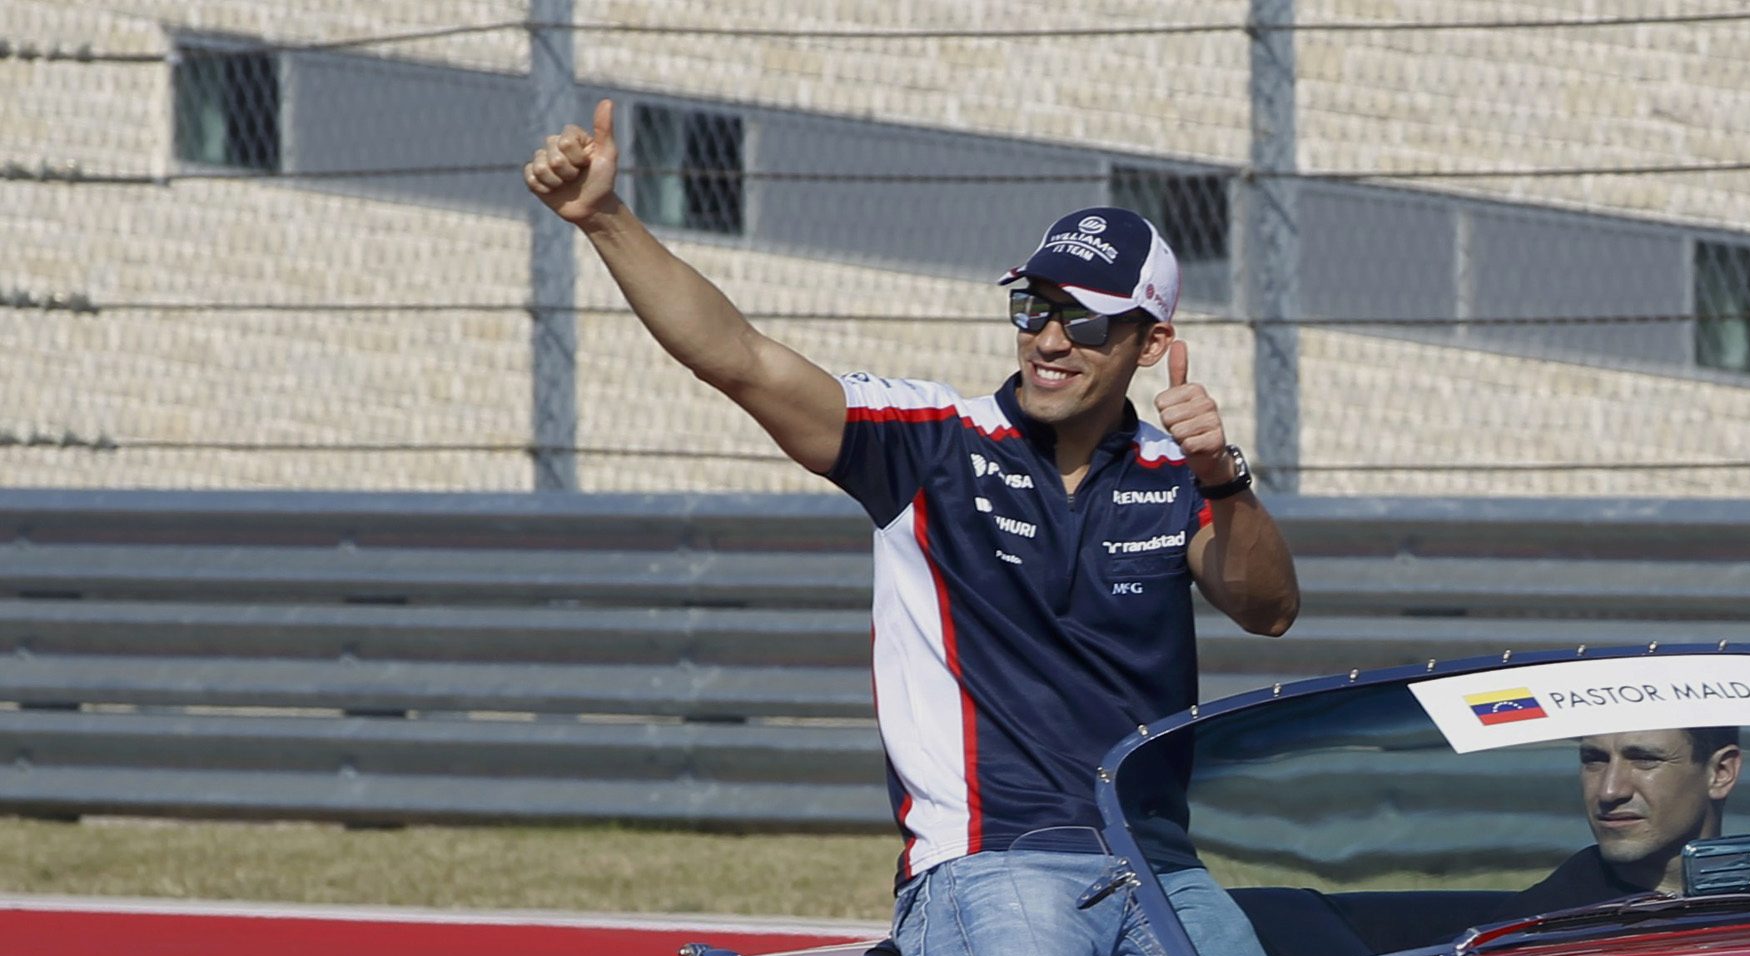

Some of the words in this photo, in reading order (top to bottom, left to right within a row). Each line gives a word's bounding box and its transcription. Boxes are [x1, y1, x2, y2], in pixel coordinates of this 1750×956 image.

[1050, 232, 1119, 260] WILLIAMS
[1066, 244, 1095, 261] TEAM
[1122, 530, 1186, 553] randstad
[1549, 684, 1666, 709] PASTOR
